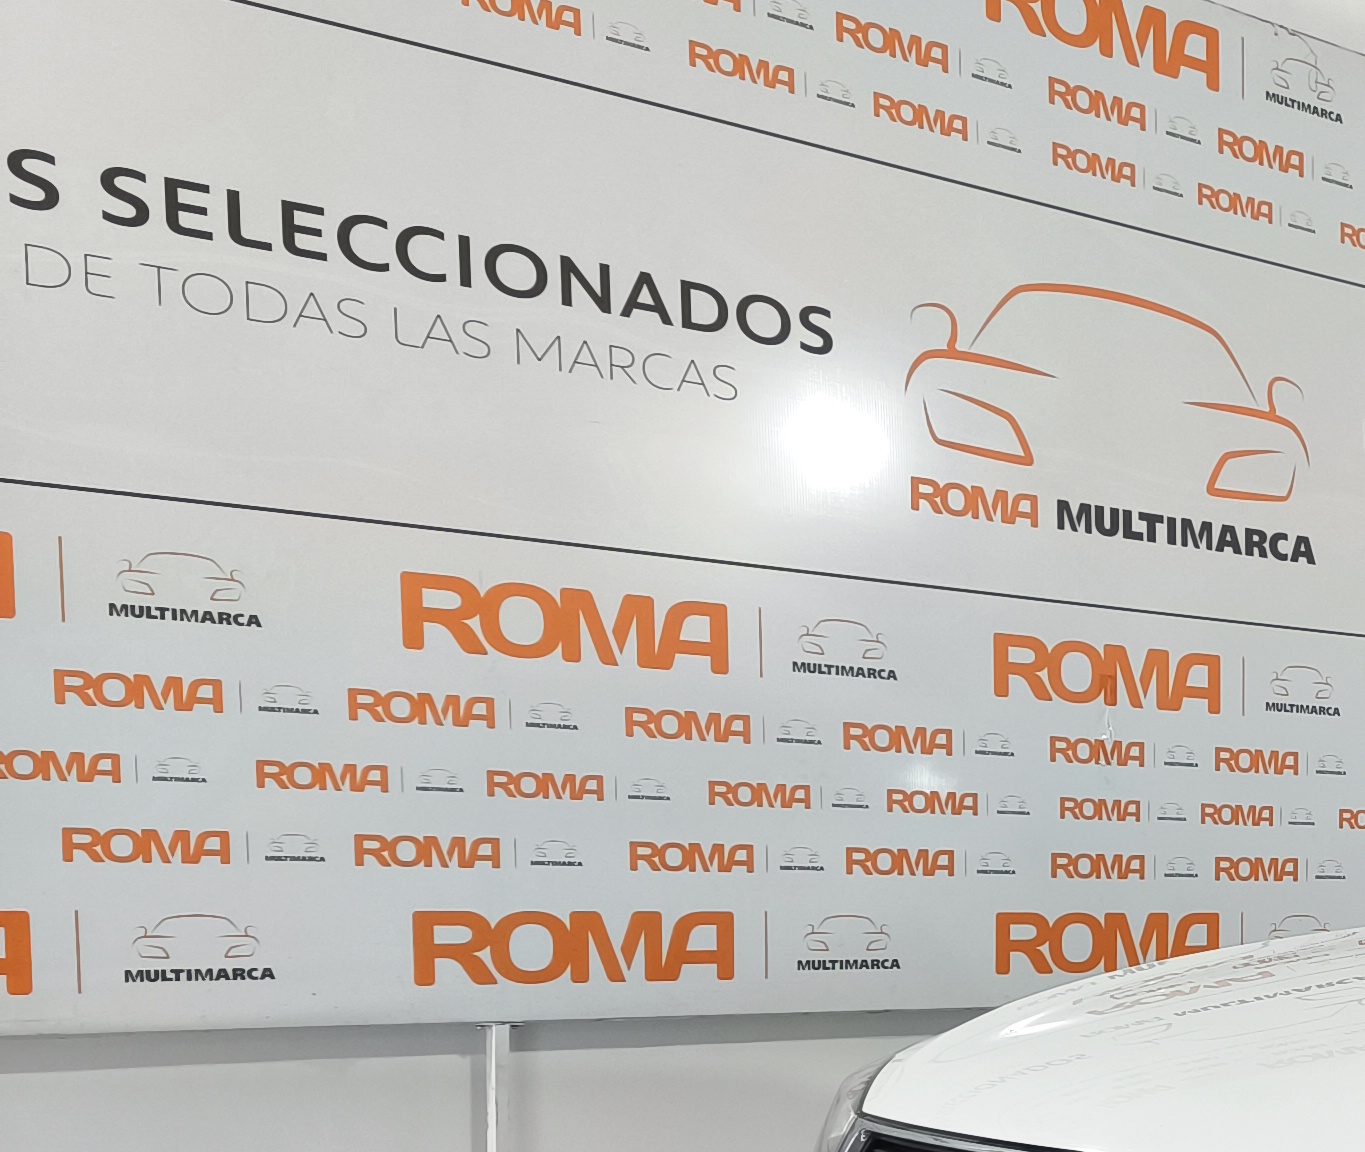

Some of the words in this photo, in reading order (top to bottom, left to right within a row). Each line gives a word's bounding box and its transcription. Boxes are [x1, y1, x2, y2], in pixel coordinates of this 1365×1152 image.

[836, 14, 948, 73] ROMA
[690, 41, 794, 93] ROMA
[874, 93, 968, 141] ROMA
[1050, 78, 1146, 131] ROMA
[1266, 91, 1343, 124] MULTIMARCA
[1053, 144, 1136, 186] ROMA
[1218, 129, 1304, 177] ROMA
[1198, 185, 1272, 223] ROMA
[100, 167, 833, 355] SELECCIONADOS
[24, 243, 114, 299] DE
[139, 263, 367, 338] TODAS
[394, 307, 490, 359] LAS
[516, 328, 737, 401] MARCAS
[912, 478, 1038, 528] ROMA
[1057, 499, 1316, 565] MULTIMARCA
[109, 603, 262, 628] MULTIMARCA
[401, 572, 729, 675] ROMA
[792, 661, 898, 681] MULTIMARCA
[994, 634, 1221, 715] ROMA
[54, 671, 224, 714] ROMA
[348, 689, 496, 729] ROMA
[1265, 702, 1340, 717] MULTIMARCA
[626, 709, 750, 744] ROMA
[844, 723, 952, 756] ROMA
[1050, 738, 1144, 767] ROMA
[1216, 749, 1298, 775] ROMA
[256, 761, 388, 793] ROMA
[488, 772, 604, 801] ROMA
[710, 782, 810, 809] ROMA
[888, 791, 978, 815] ROMA
[1060, 799, 1140, 822] ROMA
[1202, 805, 1274, 826] ROMA
[62, 829, 230, 865] ROMA
[355, 835, 500, 869] ROMA
[630, 843, 754, 873] ROMA
[846, 849, 954, 877] ROMA
[1052, 854, 1145, 880] ROMA
[1216, 858, 1298, 882] ROMA
[413, 912, 734, 987] ROMA
[996, 913, 1220, 975] ROMA
[124, 966, 276, 983] MULTIMARCA
[797, 958, 900, 971] MULTIMARCA
